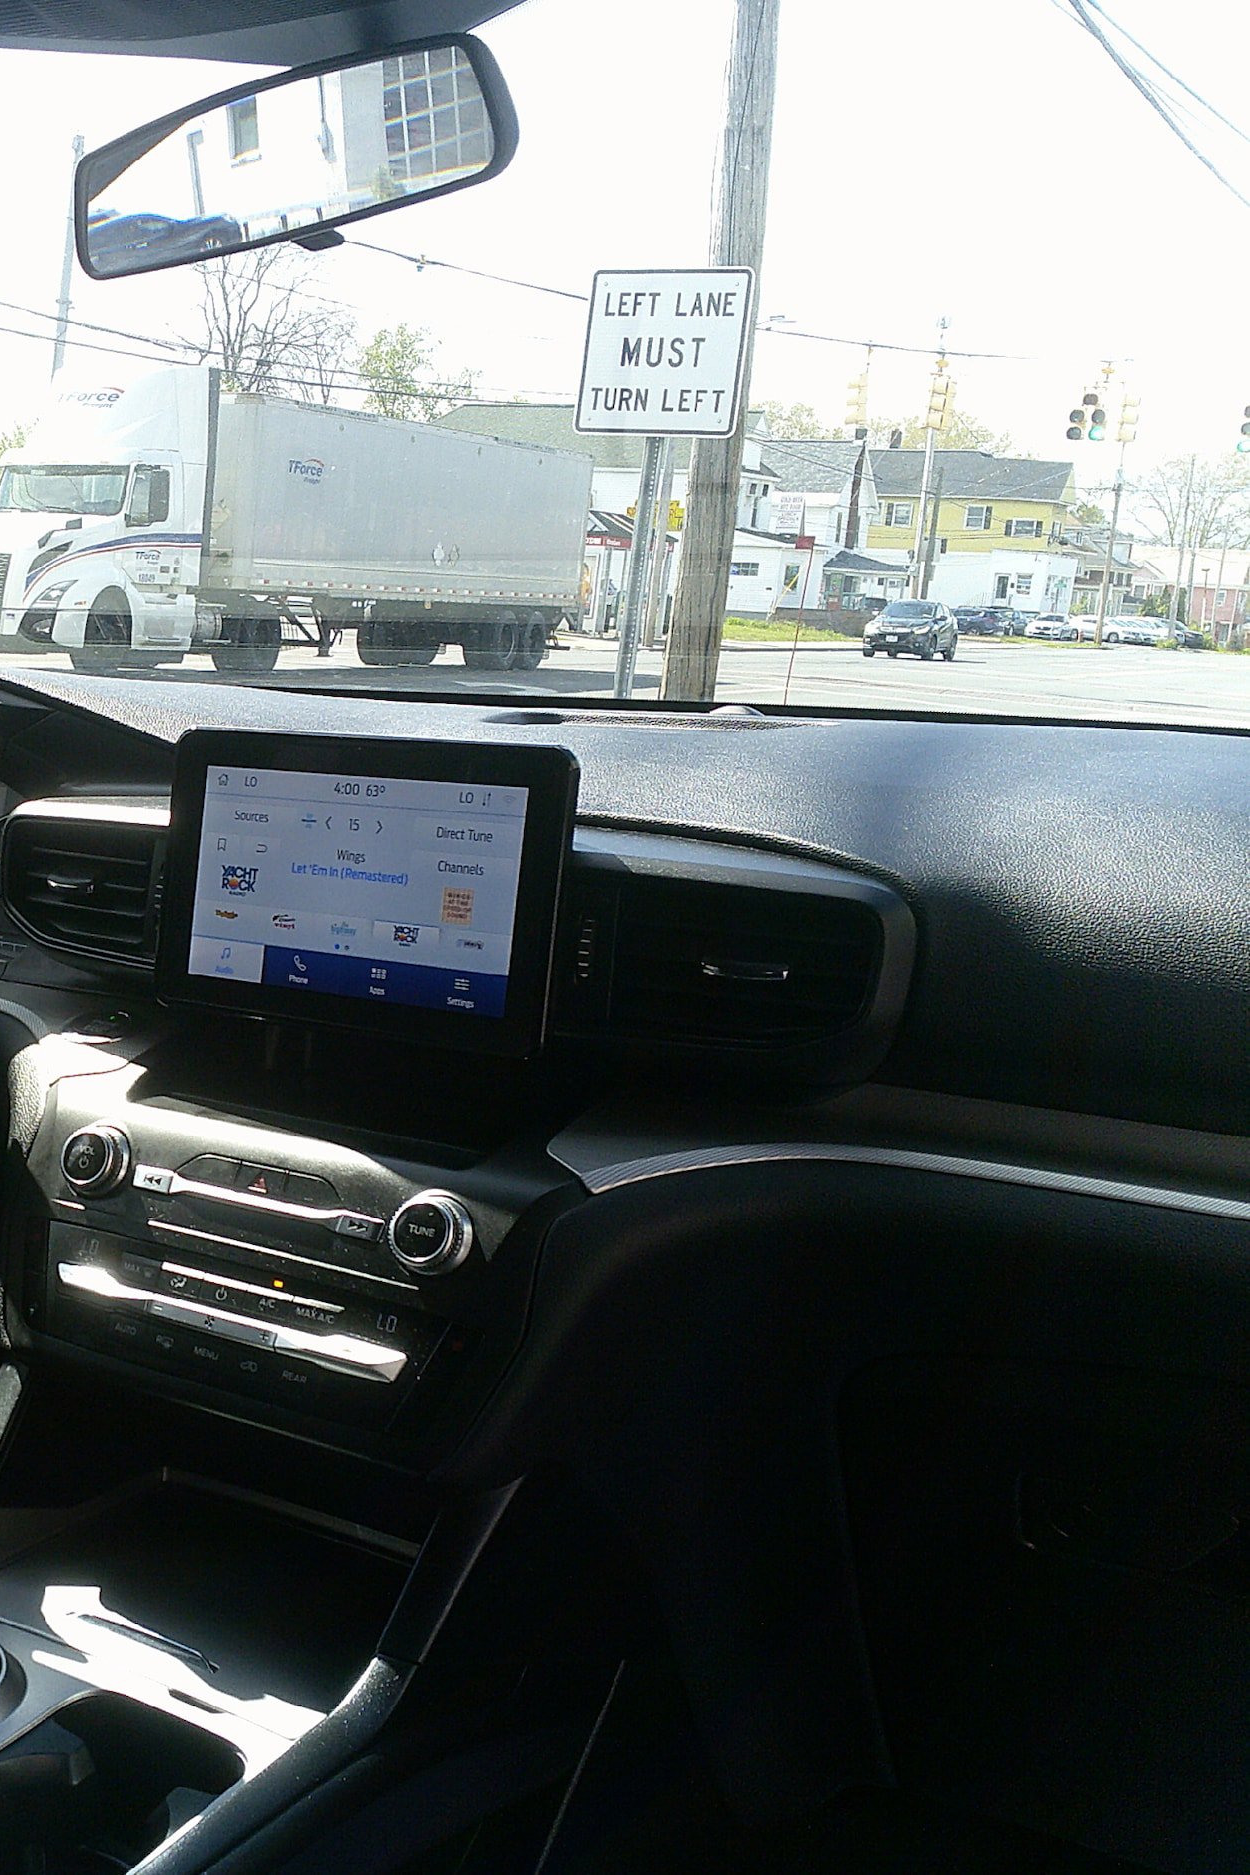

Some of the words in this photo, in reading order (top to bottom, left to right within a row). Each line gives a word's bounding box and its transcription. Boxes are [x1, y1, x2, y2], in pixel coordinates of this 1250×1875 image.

[604, 292, 661, 317] LEFT
[675, 292, 737, 317] LANE
[620, 337, 706, 368] MUST
[591, 387, 649, 412] TURN
[661, 388, 726, 413] LEFT
[288, 459, 323, 477] TForce
[244, 776, 258, 788] LO
[334, 782, 360, 795] 4:00
[459, 791, 474, 804] LO
[234, 809, 269, 823] Sources
[436, 826, 465, 840] Direct
[467, 828, 493, 843] Tune
[336, 849, 366, 864] Wings
[221, 864, 259, 880] YACHT
[291, 862, 307, 874] Let
[329, 866, 339, 878] In
[340, 867, 409, 887] (Remastered)
[437, 860, 485, 876] Channels
[221, 877, 256, 892] ROCK
[288, 974, 309, 985] Phone
[369, 985, 386, 997] Apps
[446, 996, 475, 1009] Settings
[408, 1222, 436, 1238] TUNE
[258, 1297, 276, 1310] A/C
[296, 1306, 317, 1321] MAX
[317, 1310, 335, 1325] A/C
[114, 1322, 137, 1336] AUTO
[193, 1345, 220, 1361] MENU
[281, 1369, 308, 1385] REAR
